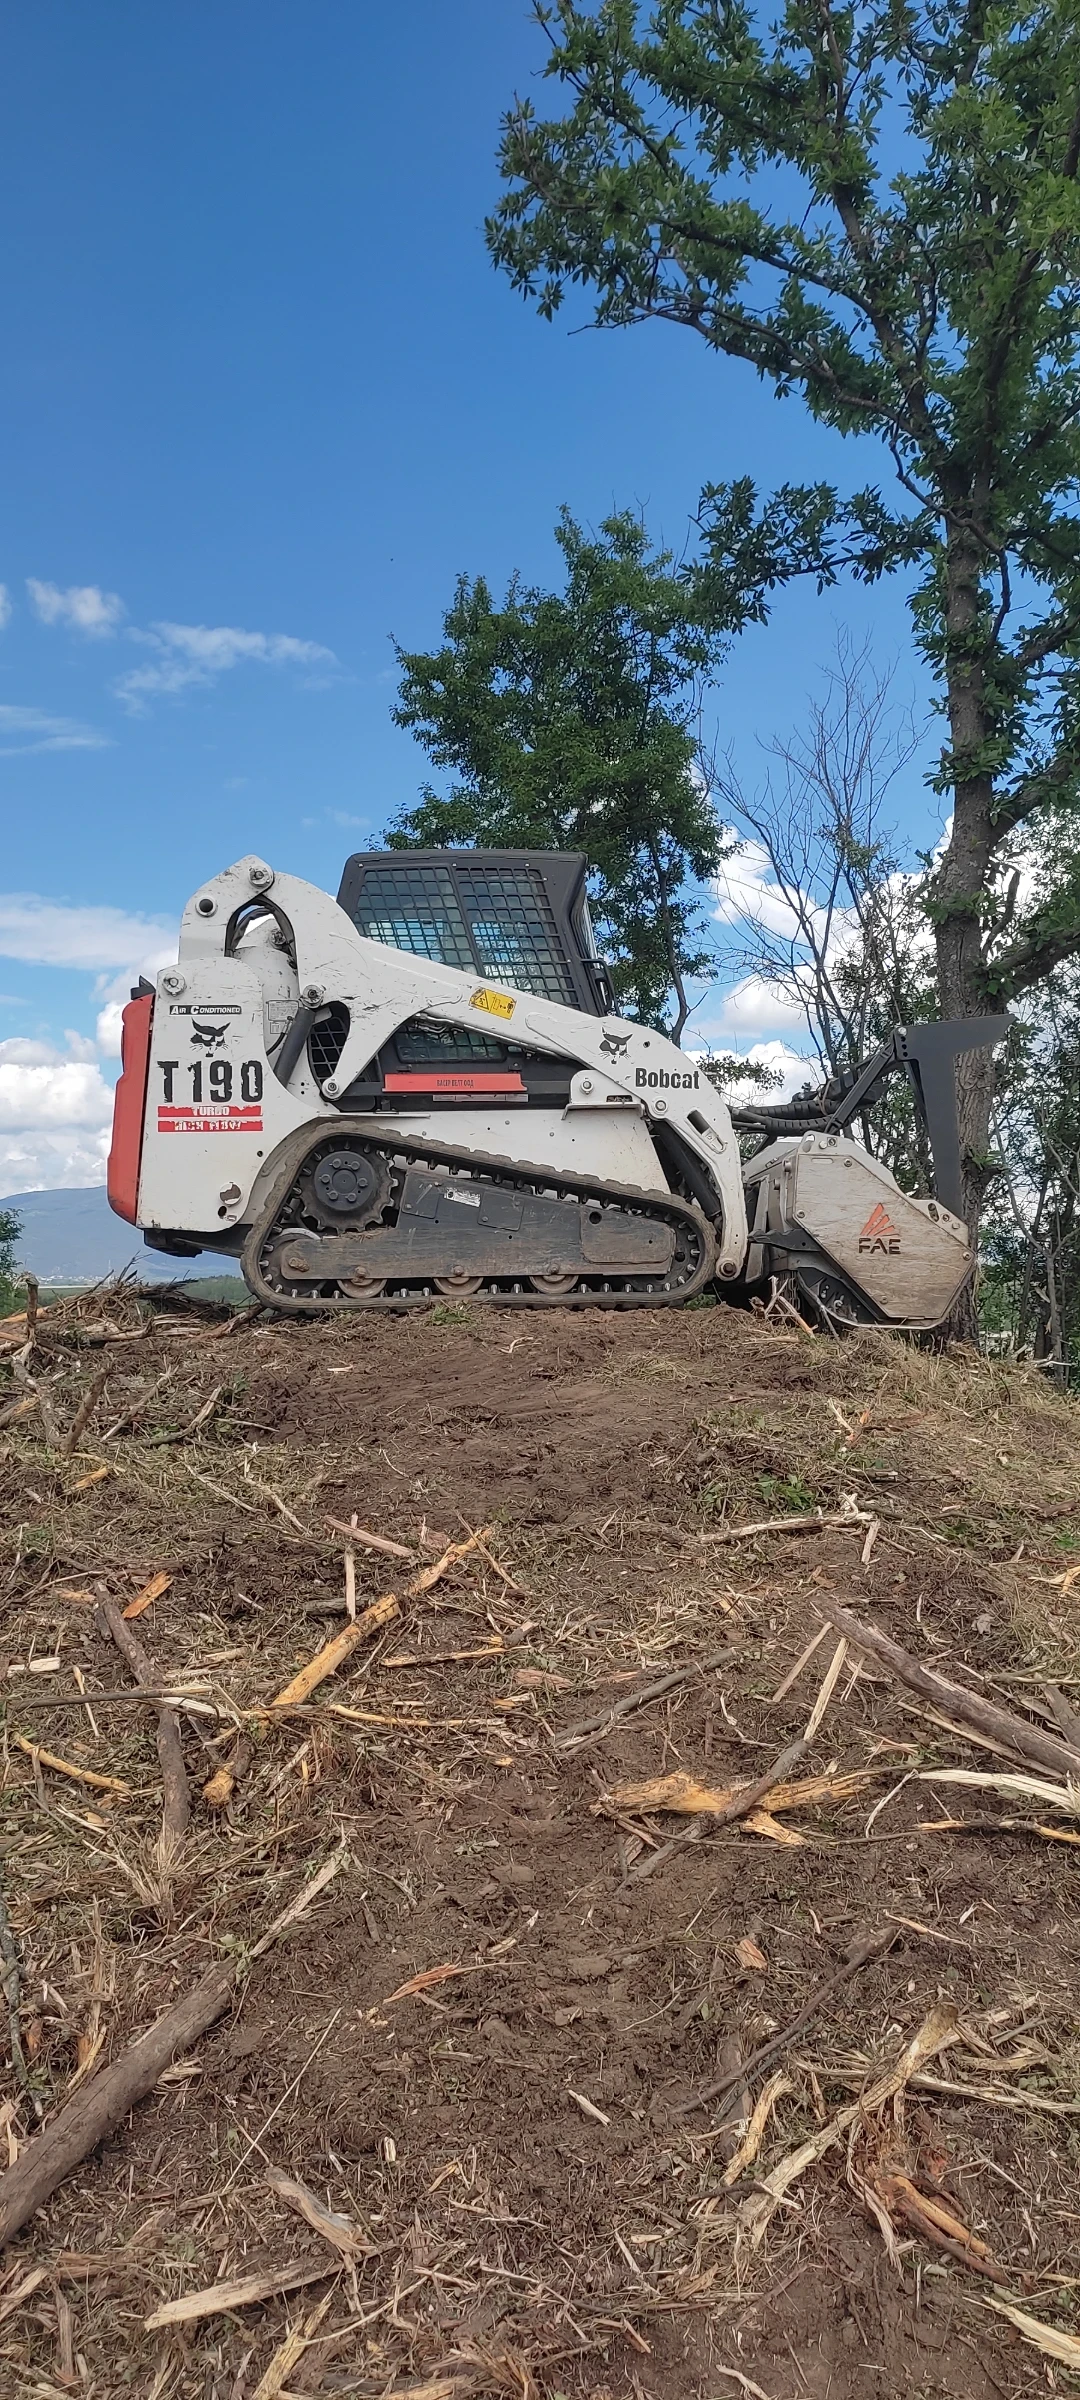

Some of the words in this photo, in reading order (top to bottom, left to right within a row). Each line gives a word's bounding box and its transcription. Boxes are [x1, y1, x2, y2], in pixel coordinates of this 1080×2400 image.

[157, 1060, 263, 1103] T190
[635, 1067, 700, 1089] Bobcat
[858, 1237, 901, 1255] FAE
